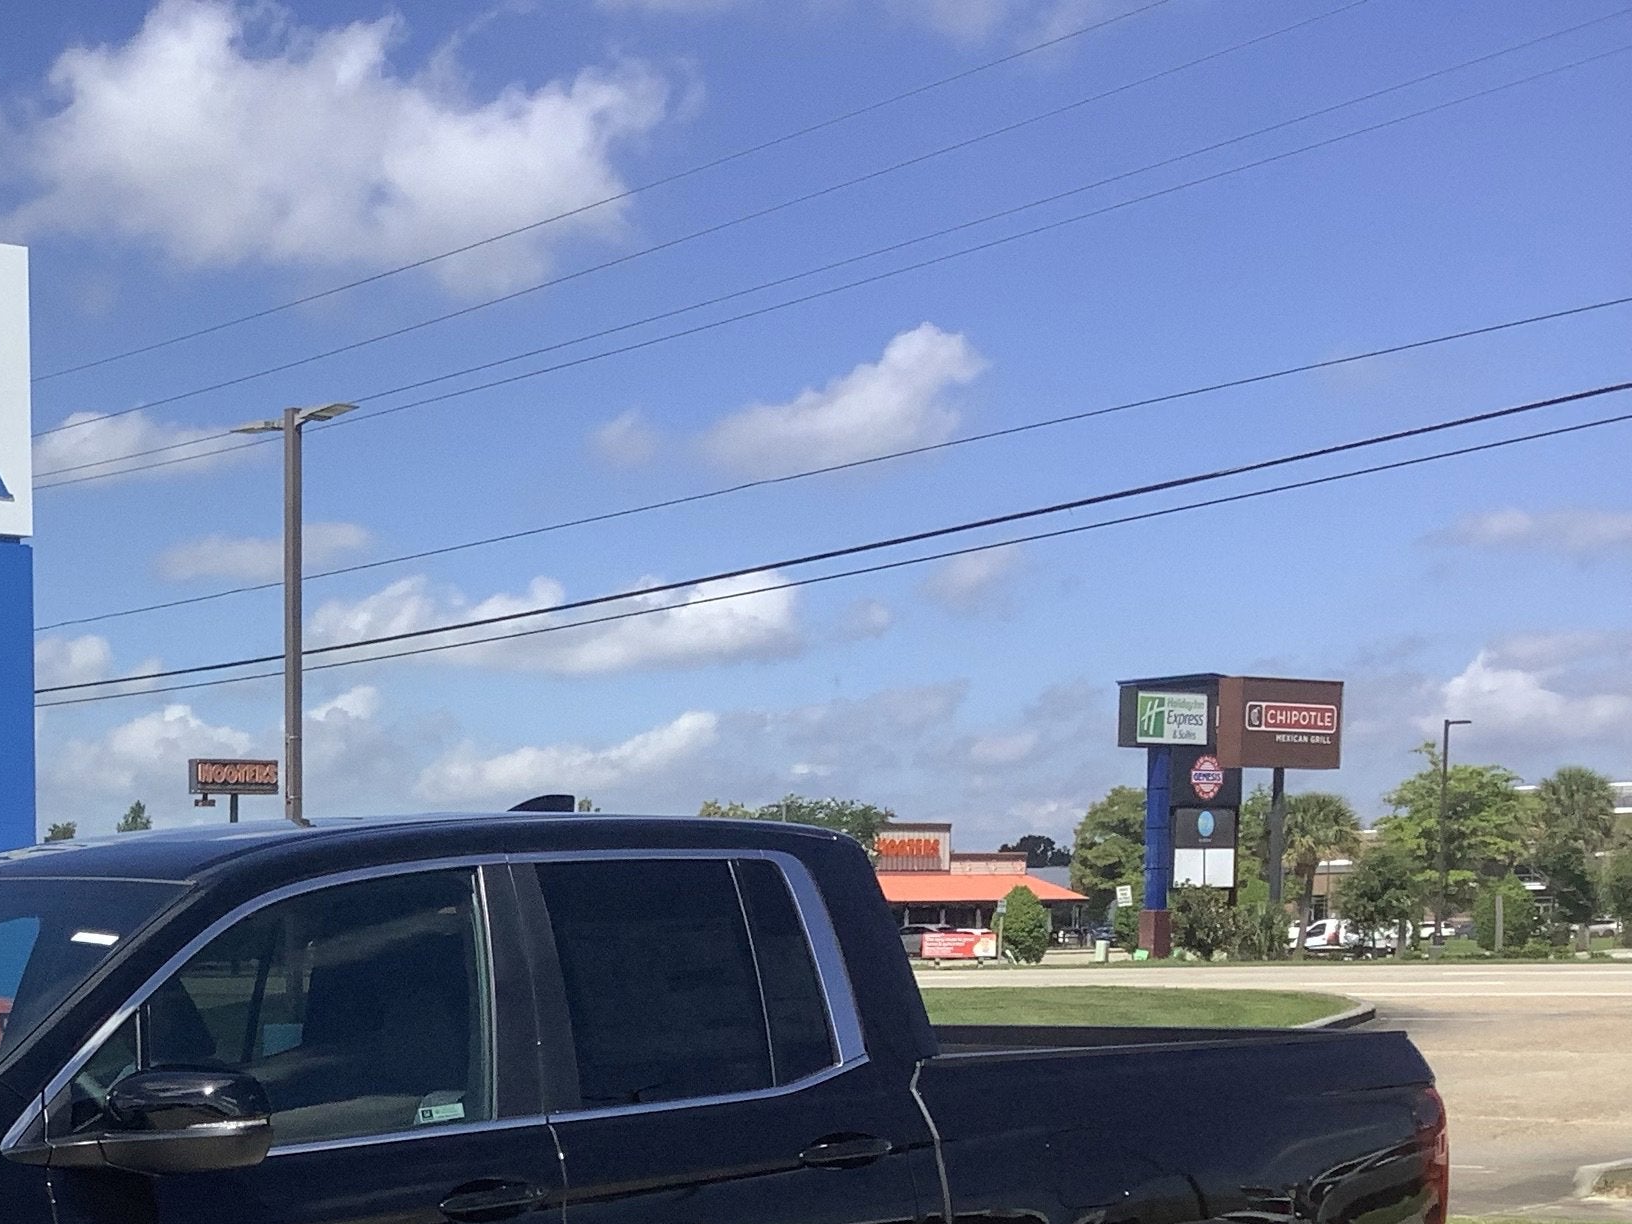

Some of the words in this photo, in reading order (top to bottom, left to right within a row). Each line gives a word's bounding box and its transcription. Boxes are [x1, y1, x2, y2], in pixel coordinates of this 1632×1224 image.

[1167, 710, 1204, 729] Express
[1267, 709, 1333, 727] CHIPOTLE
[1275, 734, 1308, 743] MEXICAN
[1310, 735, 1332, 745] GRILL
[197, 763, 277, 784] HOOTERS
[878, 837, 940, 857] HOOTERS
